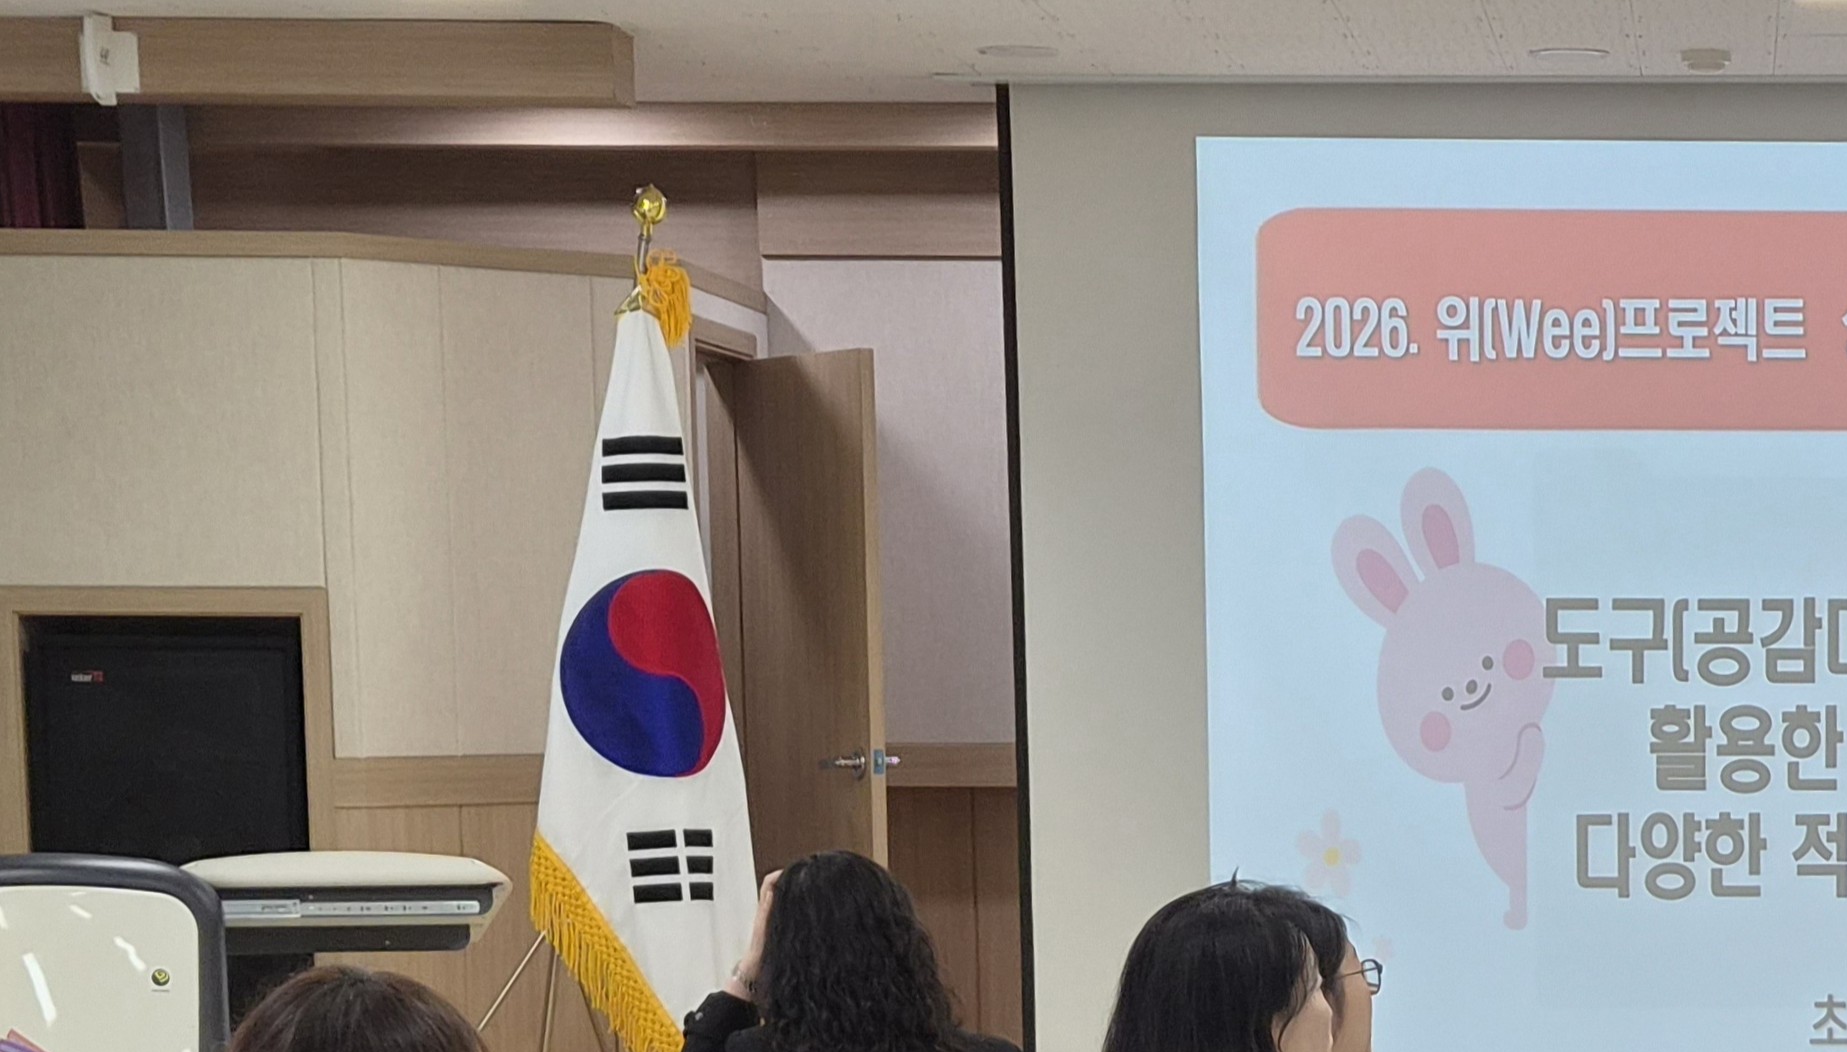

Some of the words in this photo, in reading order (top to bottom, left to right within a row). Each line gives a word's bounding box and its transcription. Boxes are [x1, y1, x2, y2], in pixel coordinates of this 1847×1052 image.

[1295, 297, 1419, 359] 2026.
[1436, 295, 1808, 363] 위(Wee)프로젝트
[1649, 705, 1846, 796] 활용한
[1575, 812, 1769, 902] 다양한
